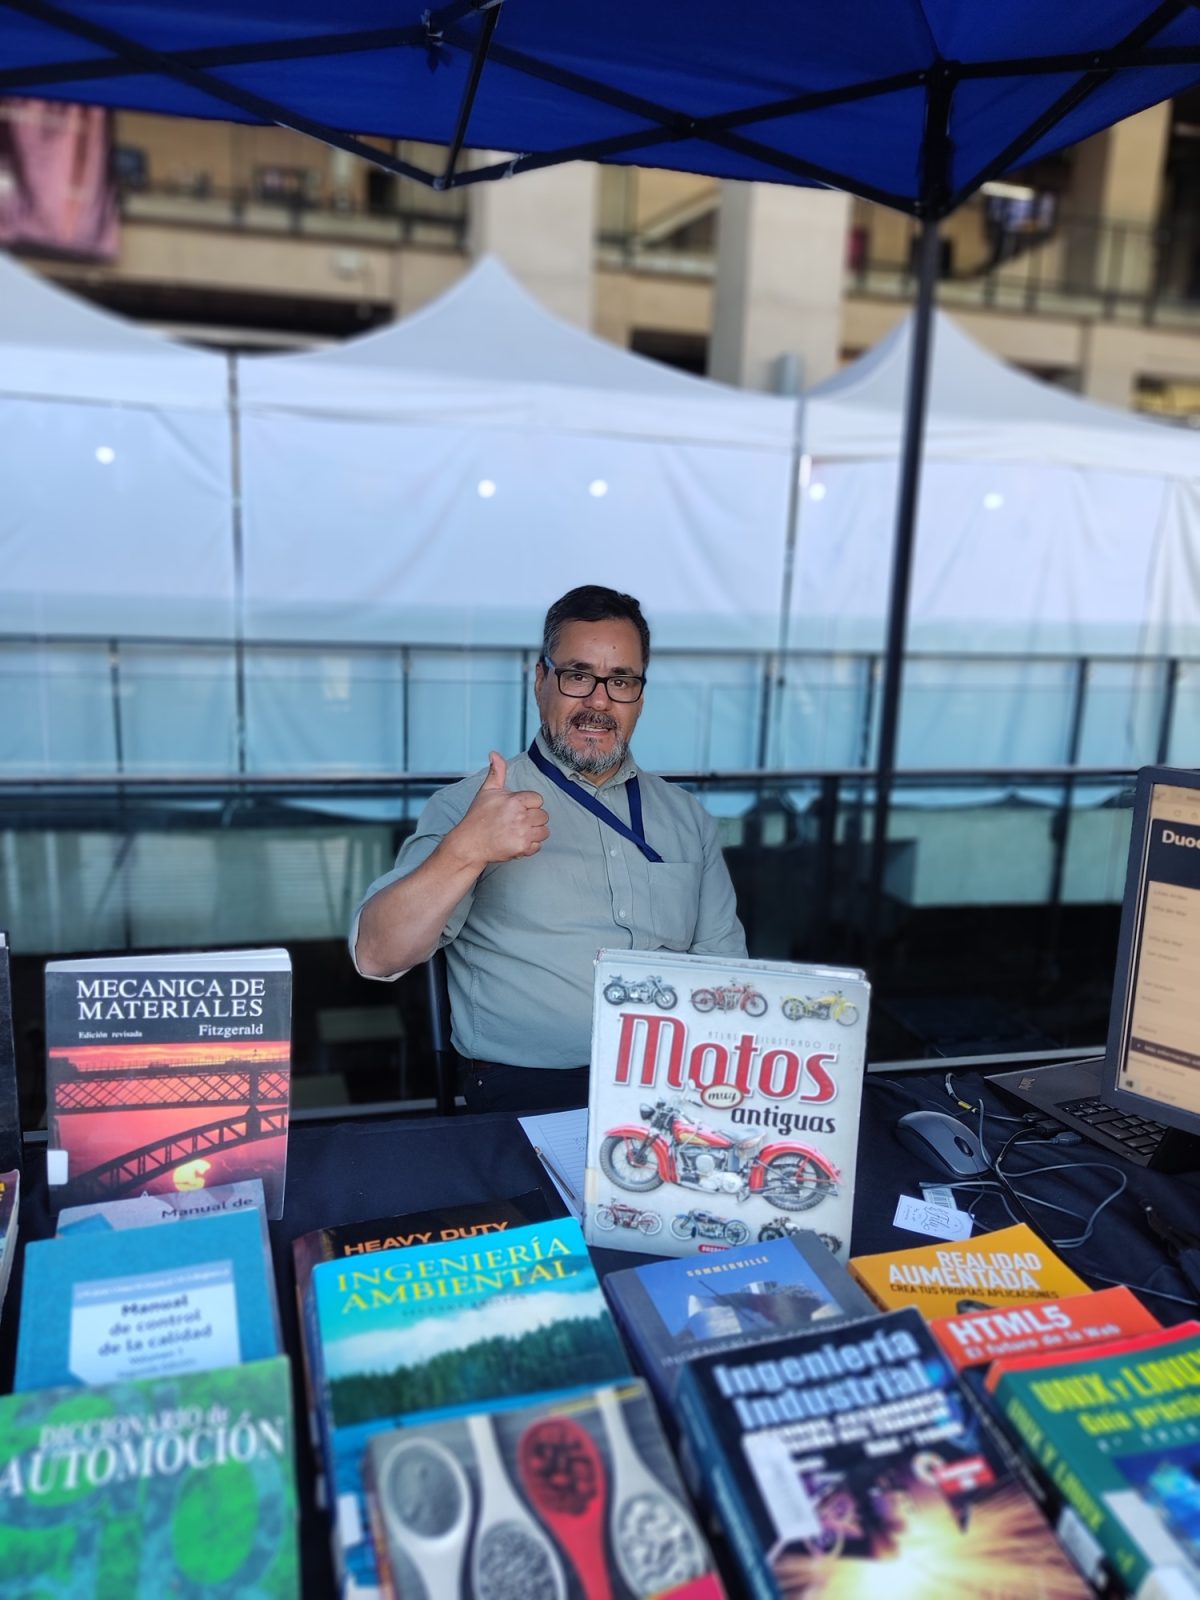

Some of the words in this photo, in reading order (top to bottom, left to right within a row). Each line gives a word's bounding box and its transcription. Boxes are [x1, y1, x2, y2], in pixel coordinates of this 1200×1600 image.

[76, 979, 225, 999] MECANICA
[229, 978, 266, 997] DE
[78, 999, 263, 1020] MATERIALES
[111, 1030, 143, 1038] revisada
[199, 1024, 264, 1039] Fitzgerald
[612, 1012, 836, 1105] Motos
[708, 1091, 737, 1102] muy
[731, 1105, 836, 1136] antiguas
[161, 1201, 229, 1218] Manual
[232, 1198, 253, 1209] de
[344, 1232, 434, 1256] HEAVY
[439, 1221, 510, 1242] DUTY
[337, 1235, 573, 1293] INGENIERÍA
[686, 1256, 769, 1277] SOMMERVILLE
[935, 1250, 1042, 1271] REALIDAD
[341, 1260, 578, 1315] AMBIENTAL
[889, 1264, 1041, 1290] AUMENTADA
[889, 1284, 917, 1293] CREA
[920, 1285, 939, 1295] TUS
[942, 1287, 984, 1297] PROPIAS
[987, 1289, 1059, 1299] APLICACIONES
[121, 1294, 189, 1316] Manual
[109, 1322, 131, 1337] de
[136, 1309, 201, 1332] control
[947, 1305, 1072, 1346] HTML5
[98, 1341, 121, 1356] de
[148, 1323, 212, 1348] calidad
[986, 1338, 1039, 1355] futuro
[1041, 1333, 1062, 1345] de
[1120, 1349, 1200, 1398] LINU
[734, 1359, 934, 1429] Industrial
[0, 1410, 284, 1497] AUTOMOCIÓN
